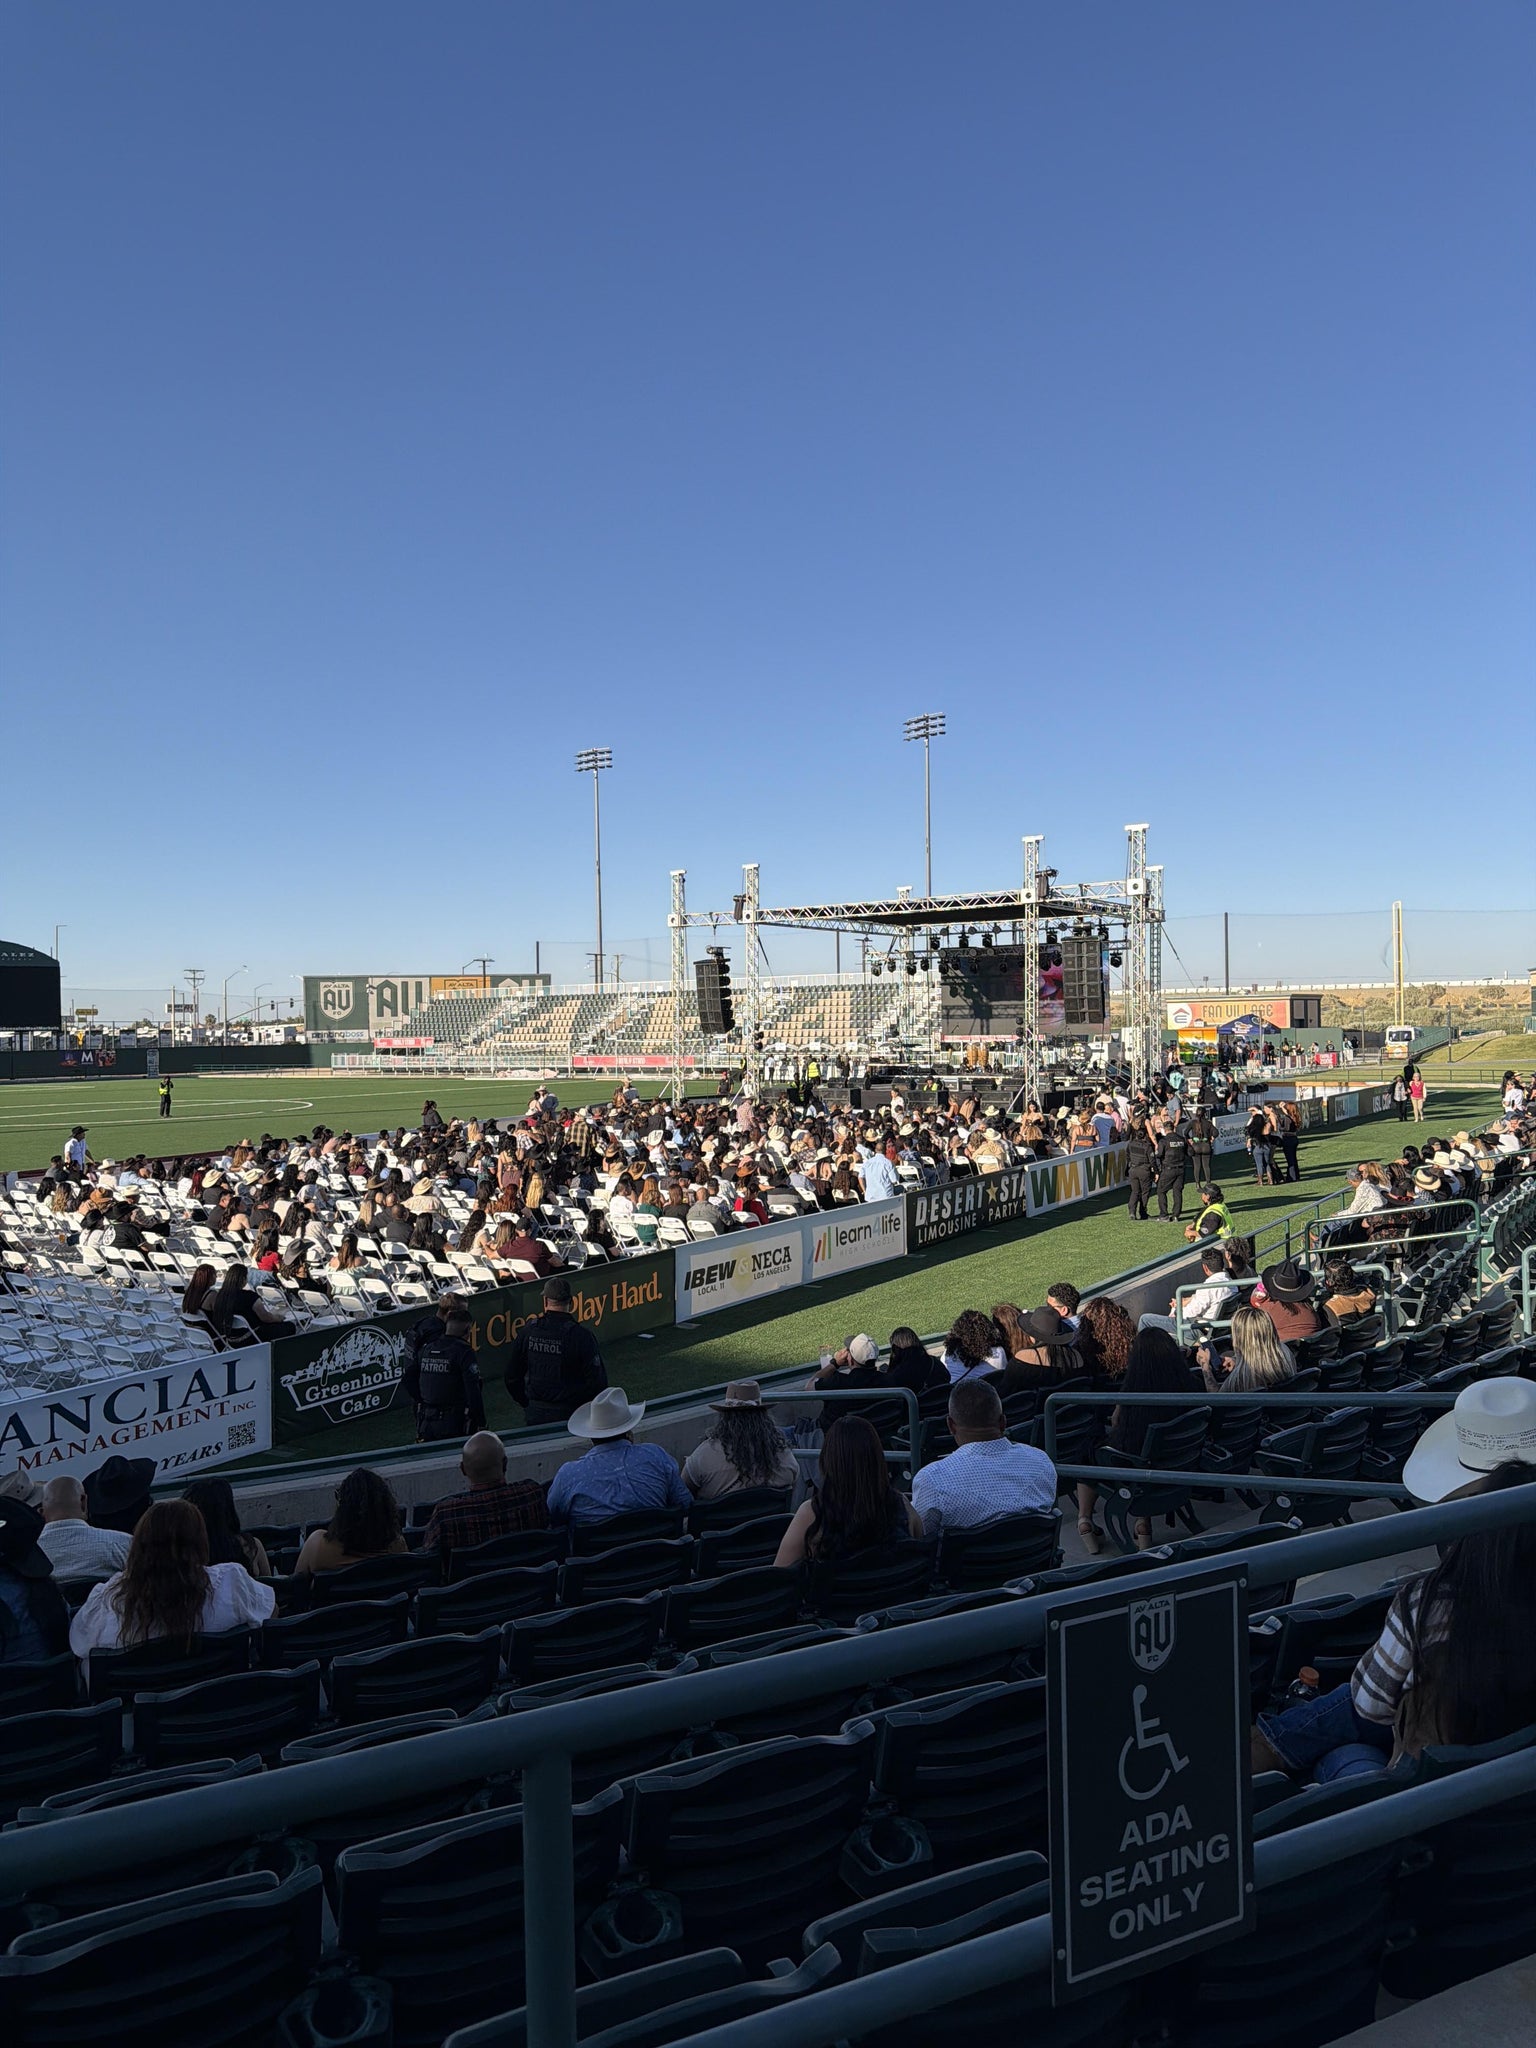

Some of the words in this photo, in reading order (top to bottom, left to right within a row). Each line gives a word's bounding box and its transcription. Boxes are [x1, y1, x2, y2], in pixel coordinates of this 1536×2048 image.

[323, 989, 350, 1011] AU
[1202, 1004, 1222, 1018] FAN
[1225, 1003, 1274, 1018] VILLAGE
[1030, 1161, 1082, 1208] WM
[1085, 1148, 1128, 1192] WM
[915, 1181, 986, 1226] DESERT
[836, 1213, 901, 1247] learn4life
[918, 1212, 977, 1244] LIMOUSINE
[988, 1201, 1019, 1222] PARTY
[684, 1259, 737, 1291] IBEW
[751, 1246, 792, 1272] NECA
[753, 1271, 765, 1280] LOS
[766, 1263, 790, 1276] ANGELES
[612, 1272, 662, 1312] Hard.
[698, 1284, 718, 1296] LOCAL
[528, 1342, 562, 1354] PATROL
[305, 1366, 405, 1402] Greenhous
[421, 1362, 449, 1373] PATROL
[340, 1394, 380, 1415] Cafe
[16, 1400, 230, 1471] MANAGEMENT
[232, 1400, 256, 1413] INC.
[160, 1441, 223, 1470] YEARS
[1134, 1605, 1147, 1614] AV
[1148, 1600, 1170, 1611] ALTA
[1134, 1610, 1171, 1656] AU
[1147, 1655, 1159, 1663] FC
[1119, 1804, 1192, 1852] ADA
[1080, 1833, 1230, 1908] SEATING
[1109, 1881, 1205, 1940] ONLY
